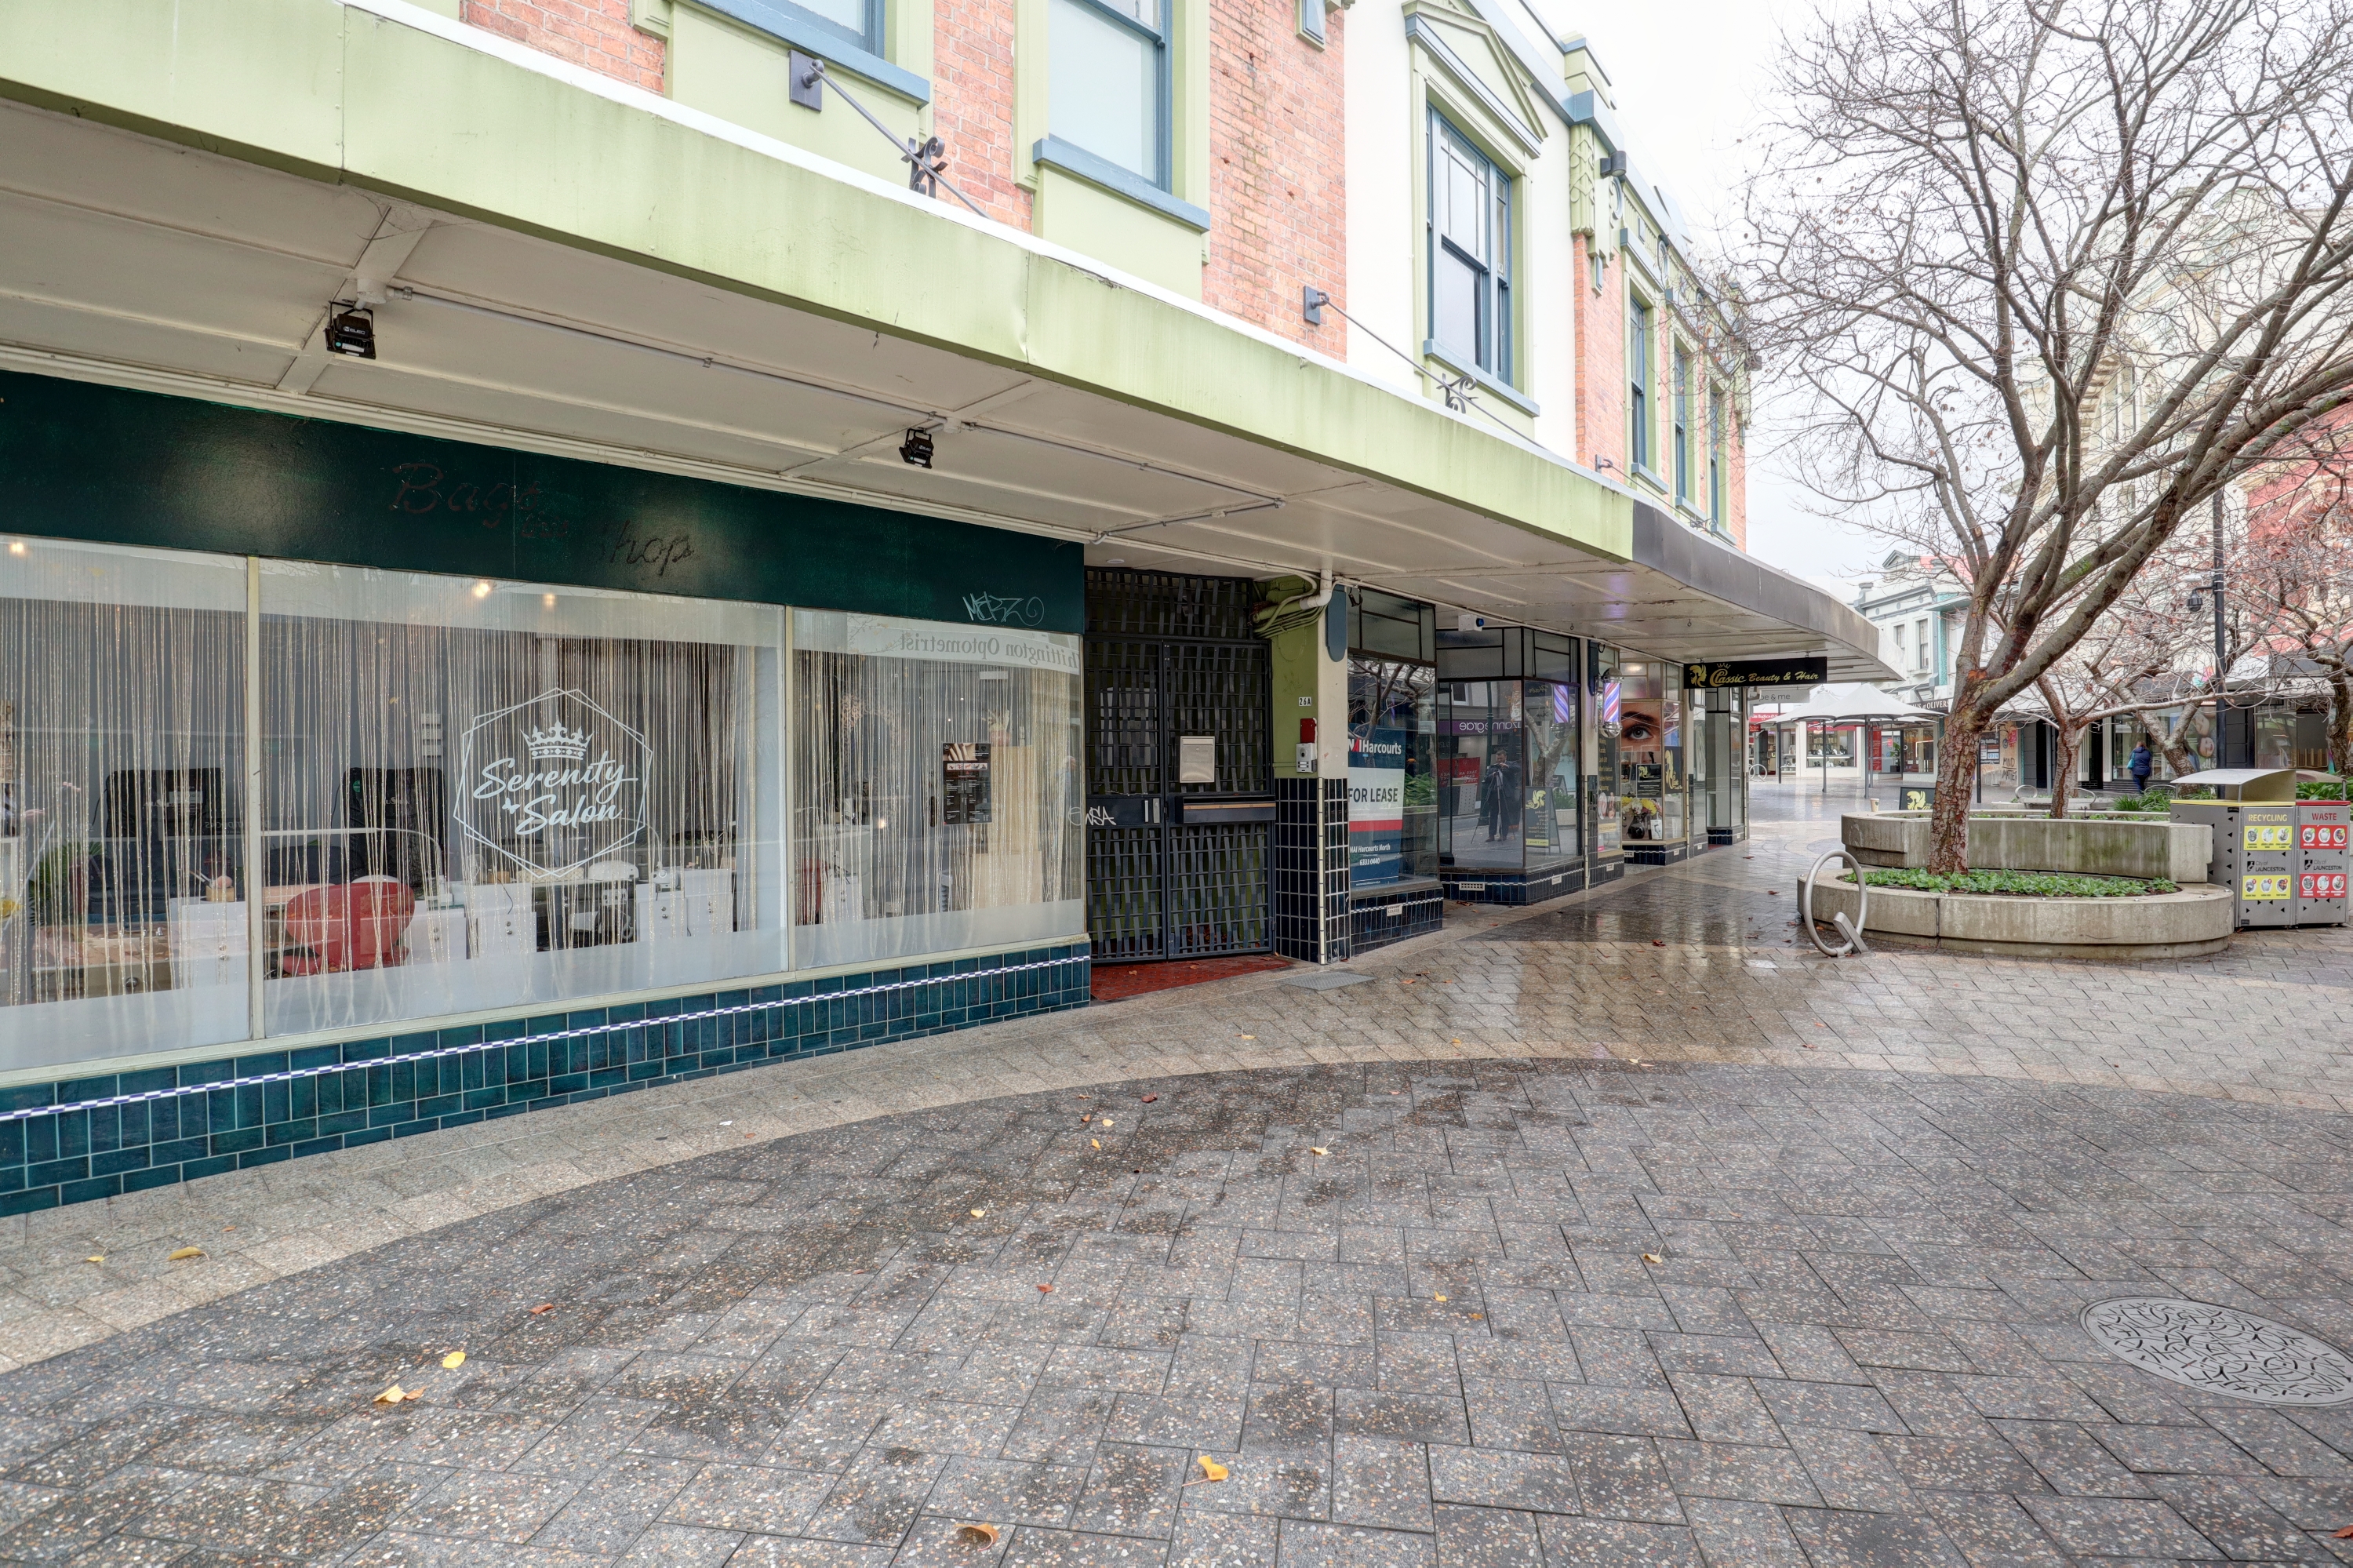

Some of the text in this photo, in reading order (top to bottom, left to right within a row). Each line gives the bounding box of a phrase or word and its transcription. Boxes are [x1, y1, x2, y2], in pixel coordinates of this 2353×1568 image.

[602, 518, 695, 576] hop
[1709, 668, 1819, 687] Classic Beauty & Hair
[1362, 740, 1402, 755] Harcourts
[473, 751, 638, 804] Serenity
[1347, 788, 1398, 802] FOR LEASE
[515, 795, 623, 835] Salon
